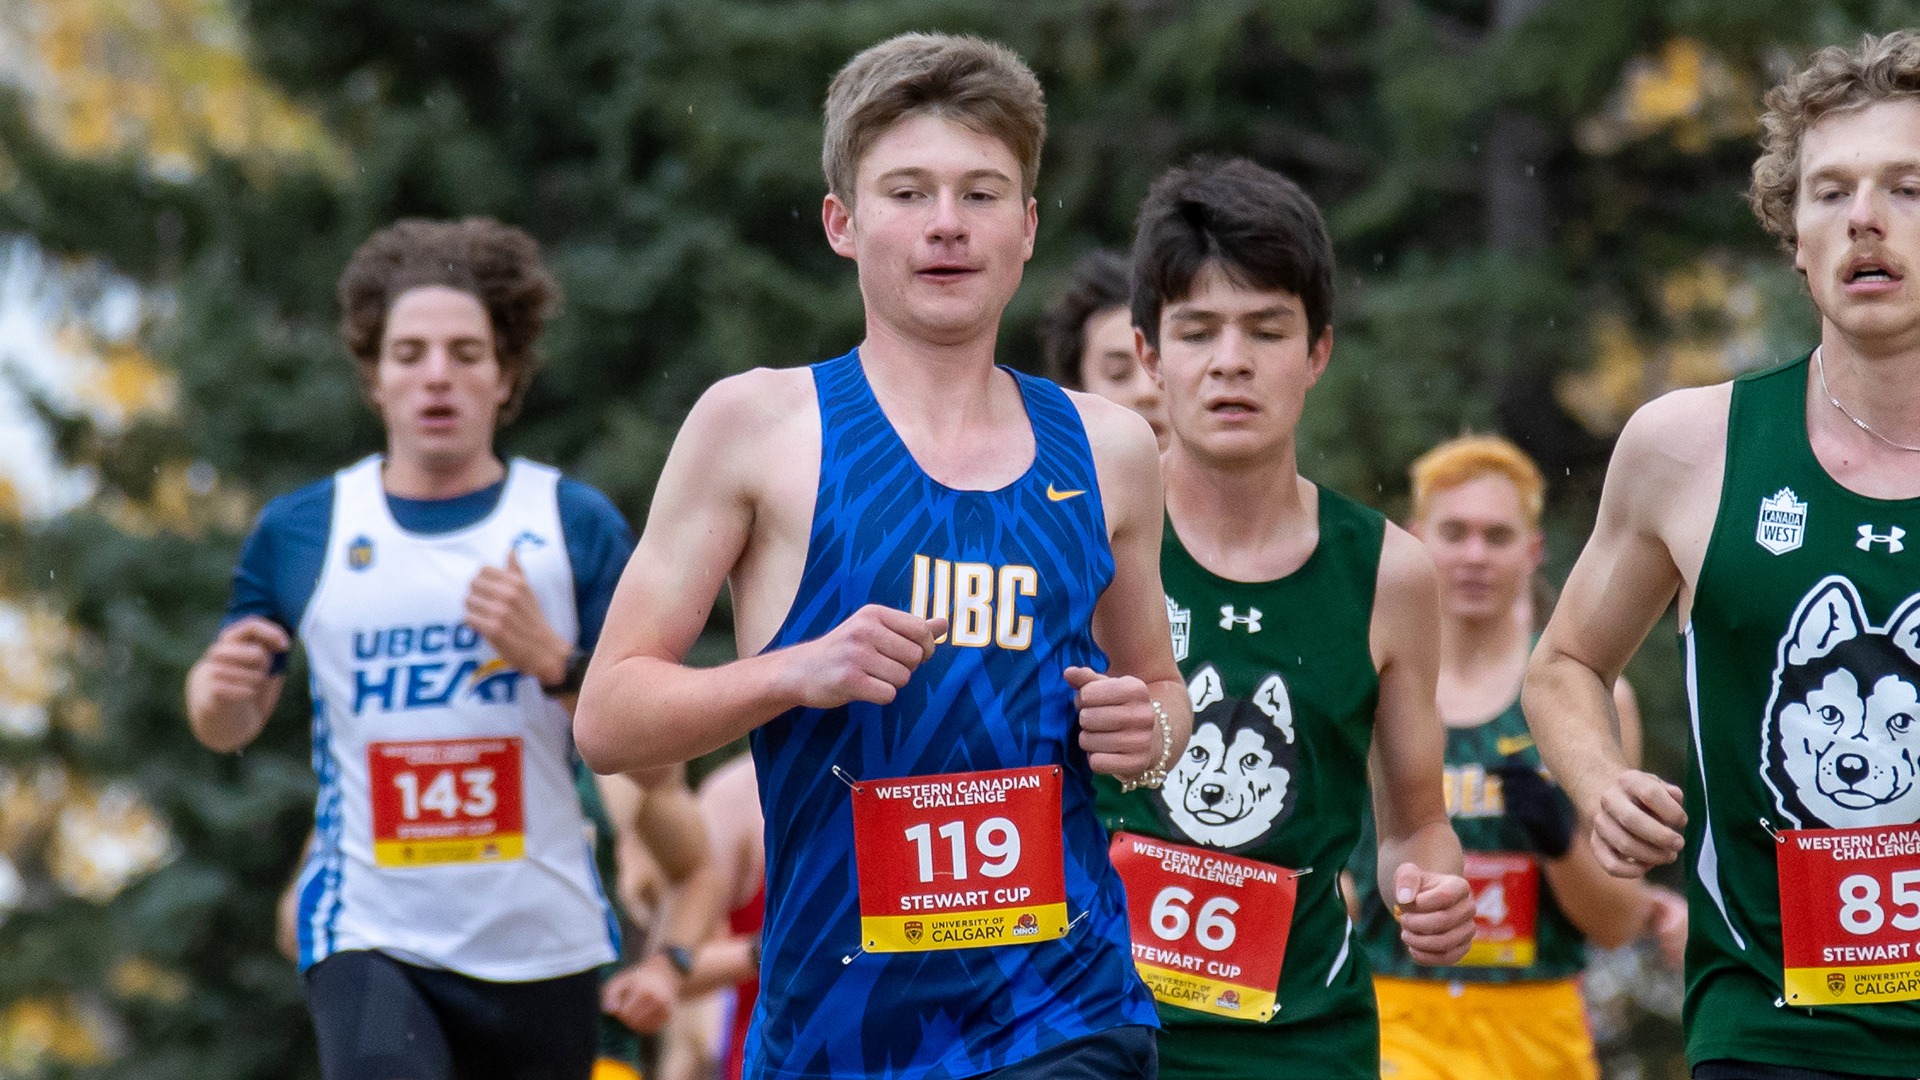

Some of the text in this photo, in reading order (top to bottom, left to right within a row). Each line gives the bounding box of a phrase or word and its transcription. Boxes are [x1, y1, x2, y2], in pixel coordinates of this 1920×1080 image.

[1764, 510, 1801, 526] CANADA
[1764, 525, 1798, 543] WEST
[911, 554, 1038, 650] UBC
[356, 624, 480, 660] UBCO
[353, 660, 521, 716] HEAT
[393, 767, 498, 820] 143
[875, 775, 1040, 799] WESTERN CANADIAN
[912, 789, 1007, 809] CHALLENGE
[904, 817, 1021, 883] 119
[1797, 831, 1920, 850] WESTERN CANA
[1133, 842, 1278, 884] WESTERN CANADIAN
[1161, 860, 1244, 888] CHALLENGE
[900, 887, 1031, 911] STEWART CUP
[1839, 869, 1920, 936] 85
[931, 917, 1004, 930] UNIVERSITY OF
[1150, 886, 1241, 952] 66
[931, 925, 1005, 943] CALGARY
[1823, 943, 1911, 962] STEWART
[1147, 973, 1198, 989] UNIVERSITY
[1207, 961, 1242, 979] CUP
[1854, 971, 1911, 982] UNIVERSITY
[1854, 978, 1920, 996] CALGAR
